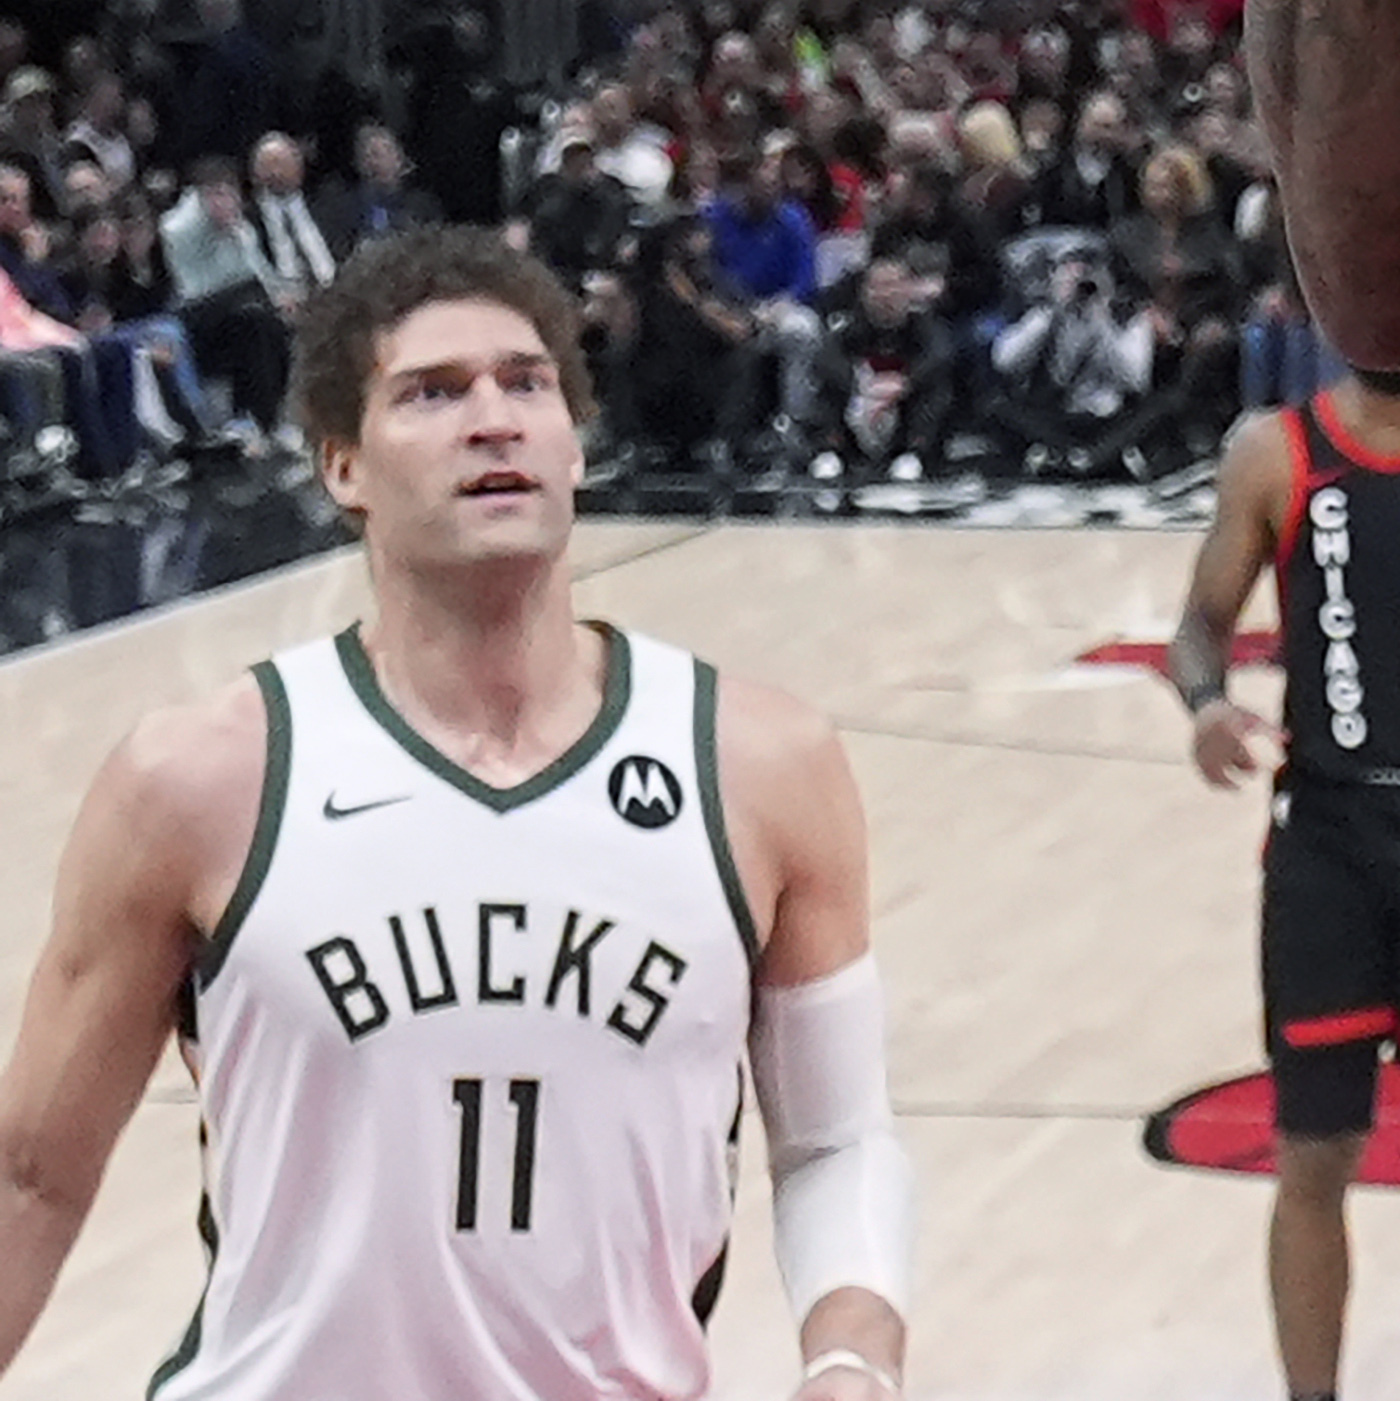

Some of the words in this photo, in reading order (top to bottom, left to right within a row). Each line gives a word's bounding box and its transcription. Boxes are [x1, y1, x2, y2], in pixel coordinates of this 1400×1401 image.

[1309, 486, 1368, 750] CHICAGO
[304, 900, 688, 1046] BUCKS
[452, 1078, 541, 1232] 11
